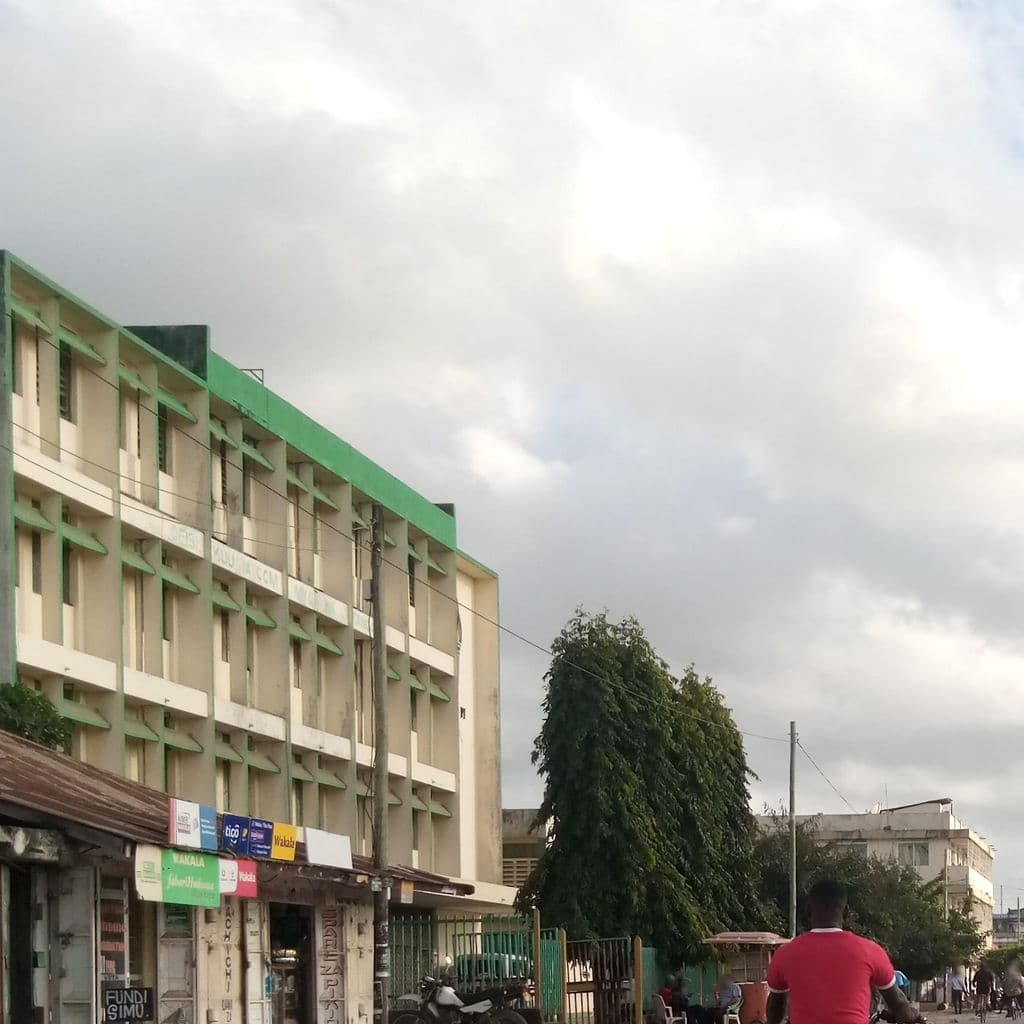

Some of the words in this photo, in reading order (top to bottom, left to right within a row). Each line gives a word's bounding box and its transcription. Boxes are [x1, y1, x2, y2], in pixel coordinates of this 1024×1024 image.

[225, 825, 240, 845] tigo
[172, 852, 205, 867] WAKALA
[106, 990, 147, 1005] FUNDI
